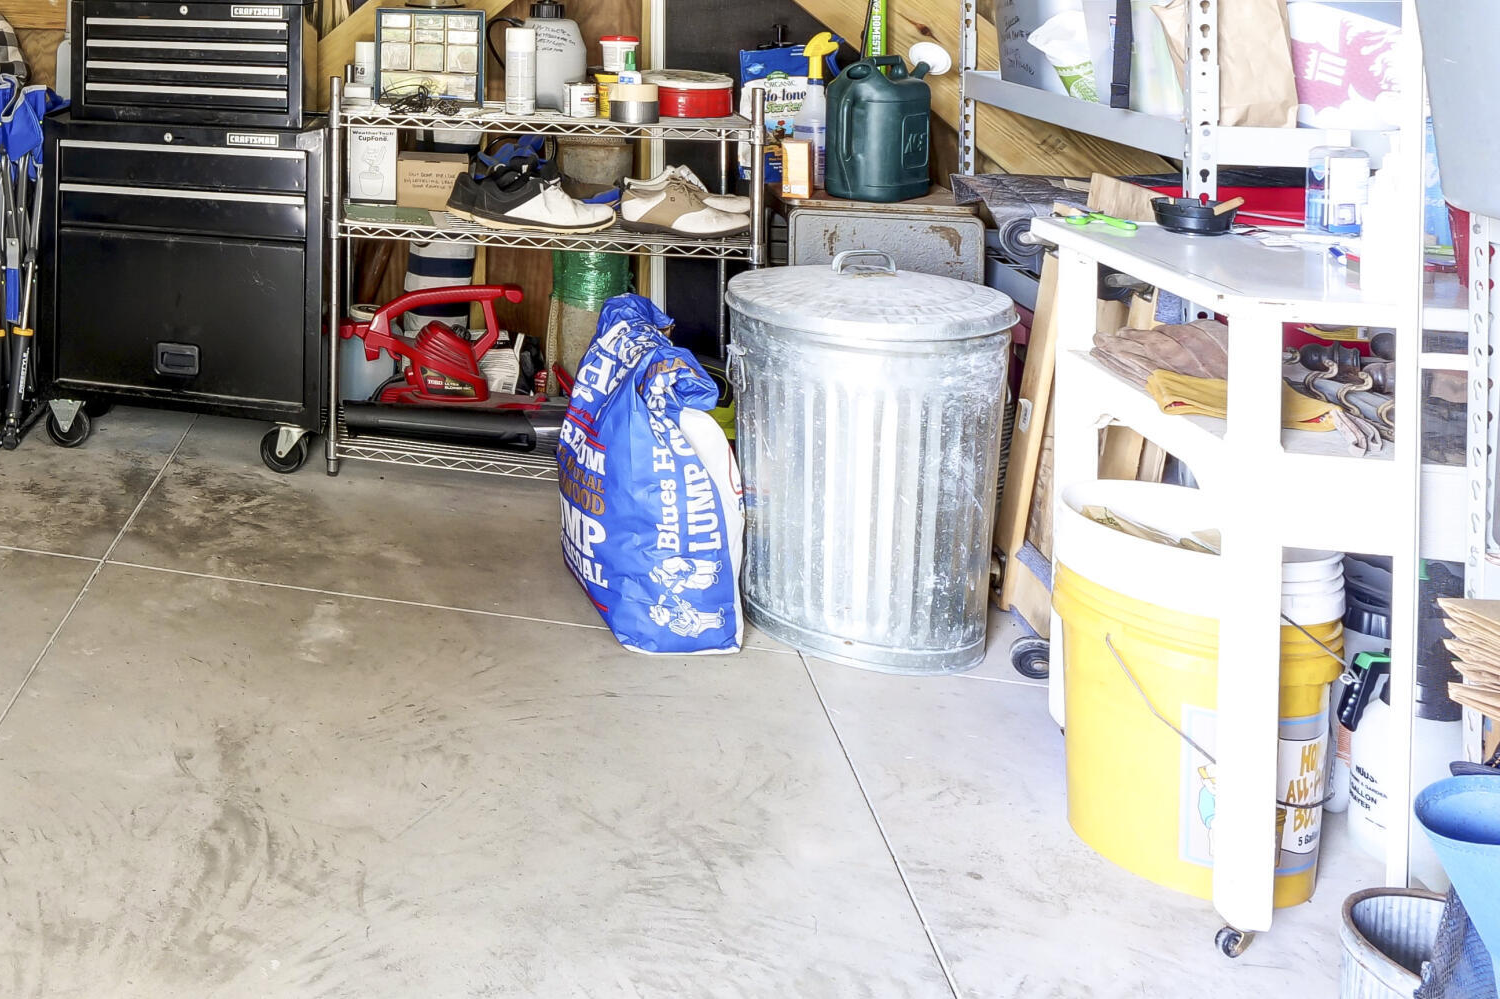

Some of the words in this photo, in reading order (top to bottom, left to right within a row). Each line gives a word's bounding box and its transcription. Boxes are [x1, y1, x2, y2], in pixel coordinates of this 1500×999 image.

[234, 7, 280, 16] CRAFTSMAN
[764, 80, 797, 89] ORGANIC
[765, 102, 802, 113] Starter
[230, 135, 276, 145] CRAFTSMAN
[684, 465, 723, 553] LUMP
[656, 479, 680, 552] Blues
[1298, 836, 1303, 846] 5
